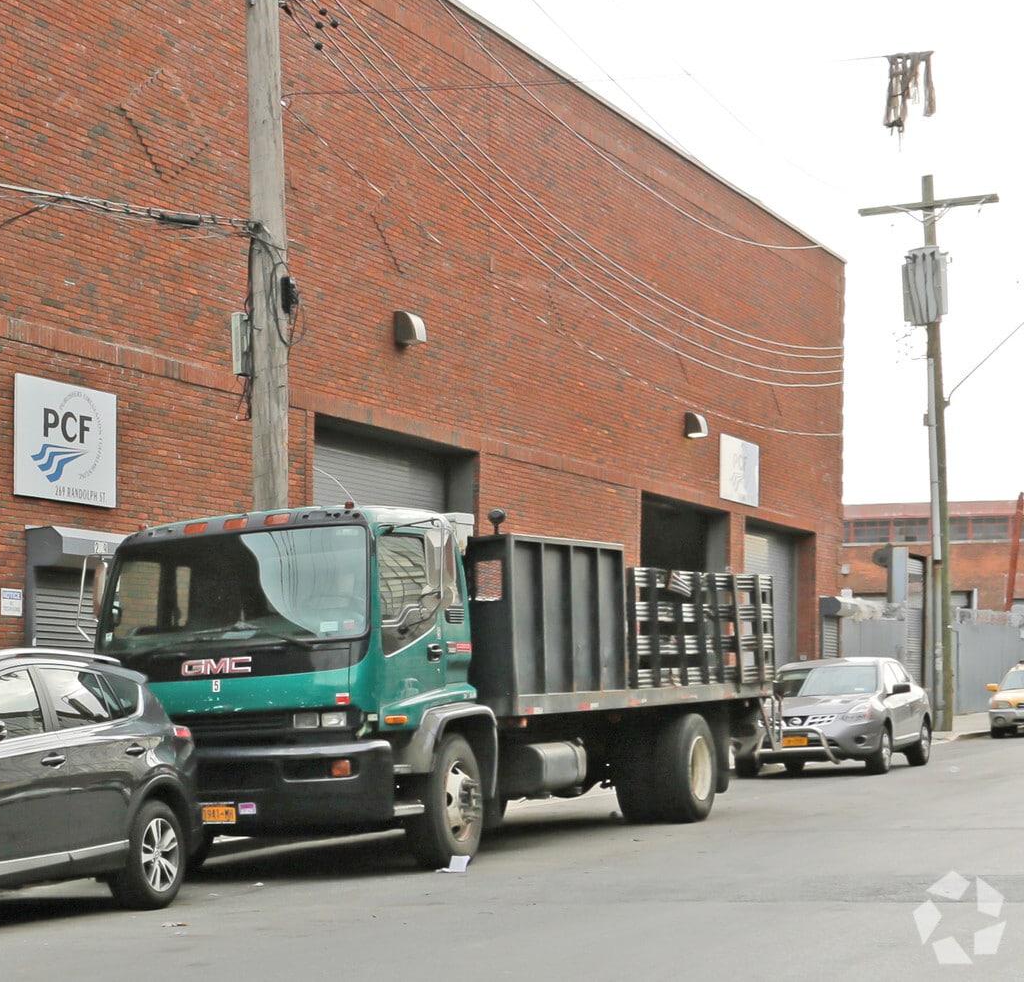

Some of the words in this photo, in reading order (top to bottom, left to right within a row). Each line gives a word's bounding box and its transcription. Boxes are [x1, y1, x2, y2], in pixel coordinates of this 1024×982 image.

[43, 407, 92, 444] PCF
[733, 452, 748, 471] PCF
[55, 485, 66, 497] 269
[67, 487, 98, 501] RANDOLPH
[181, 656, 252, 677] GMC
[214, 680, 219, 692] 5
